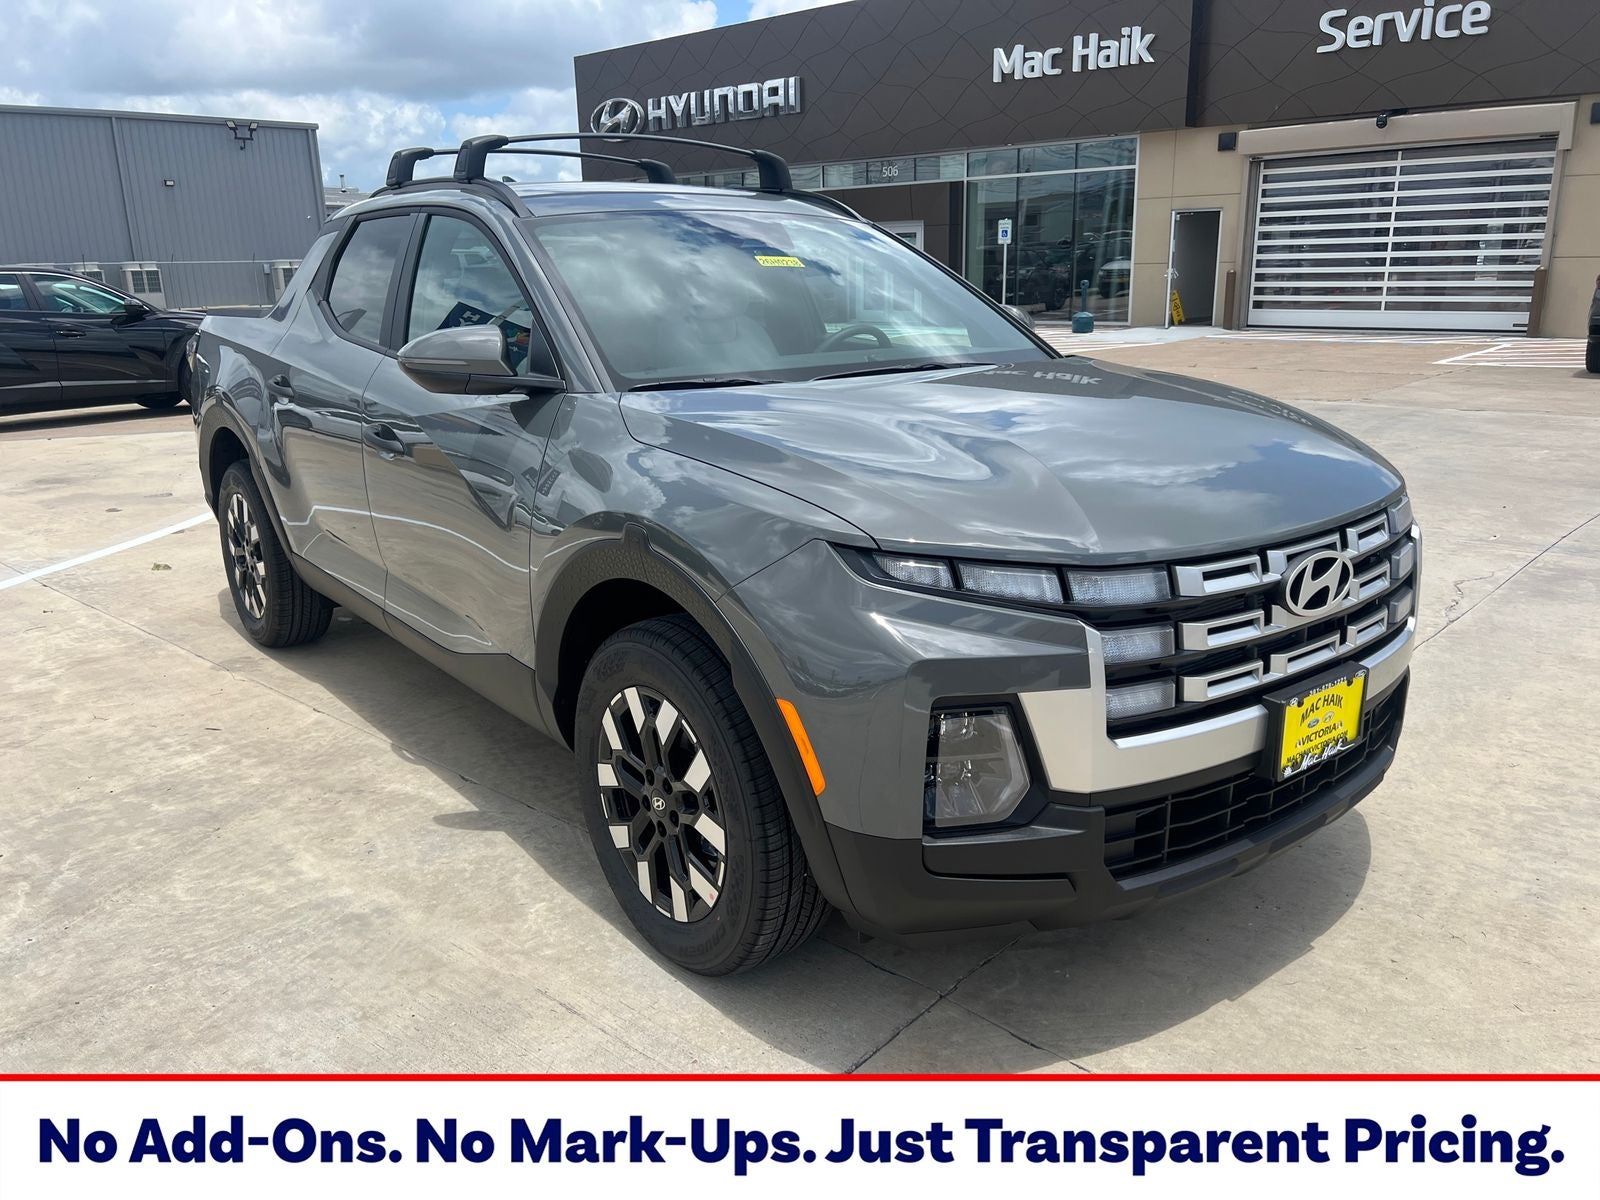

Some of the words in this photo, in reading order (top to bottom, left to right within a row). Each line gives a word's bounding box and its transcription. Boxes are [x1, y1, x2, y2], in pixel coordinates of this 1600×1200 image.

[1316, 0, 1492, 54] Service
[992, 44, 1063, 83] Mac
[1072, 25, 1156, 73] Haik
[647, 76, 801, 132] HYUNDAI
[882, 165, 899, 177] 506
[1299, 697, 1321, 727] MAC
[1322, 693, 1343, 708] HAIK
[1301, 722, 1339, 746] VICTORIA
[1299, 752, 1322, 771] Mac
